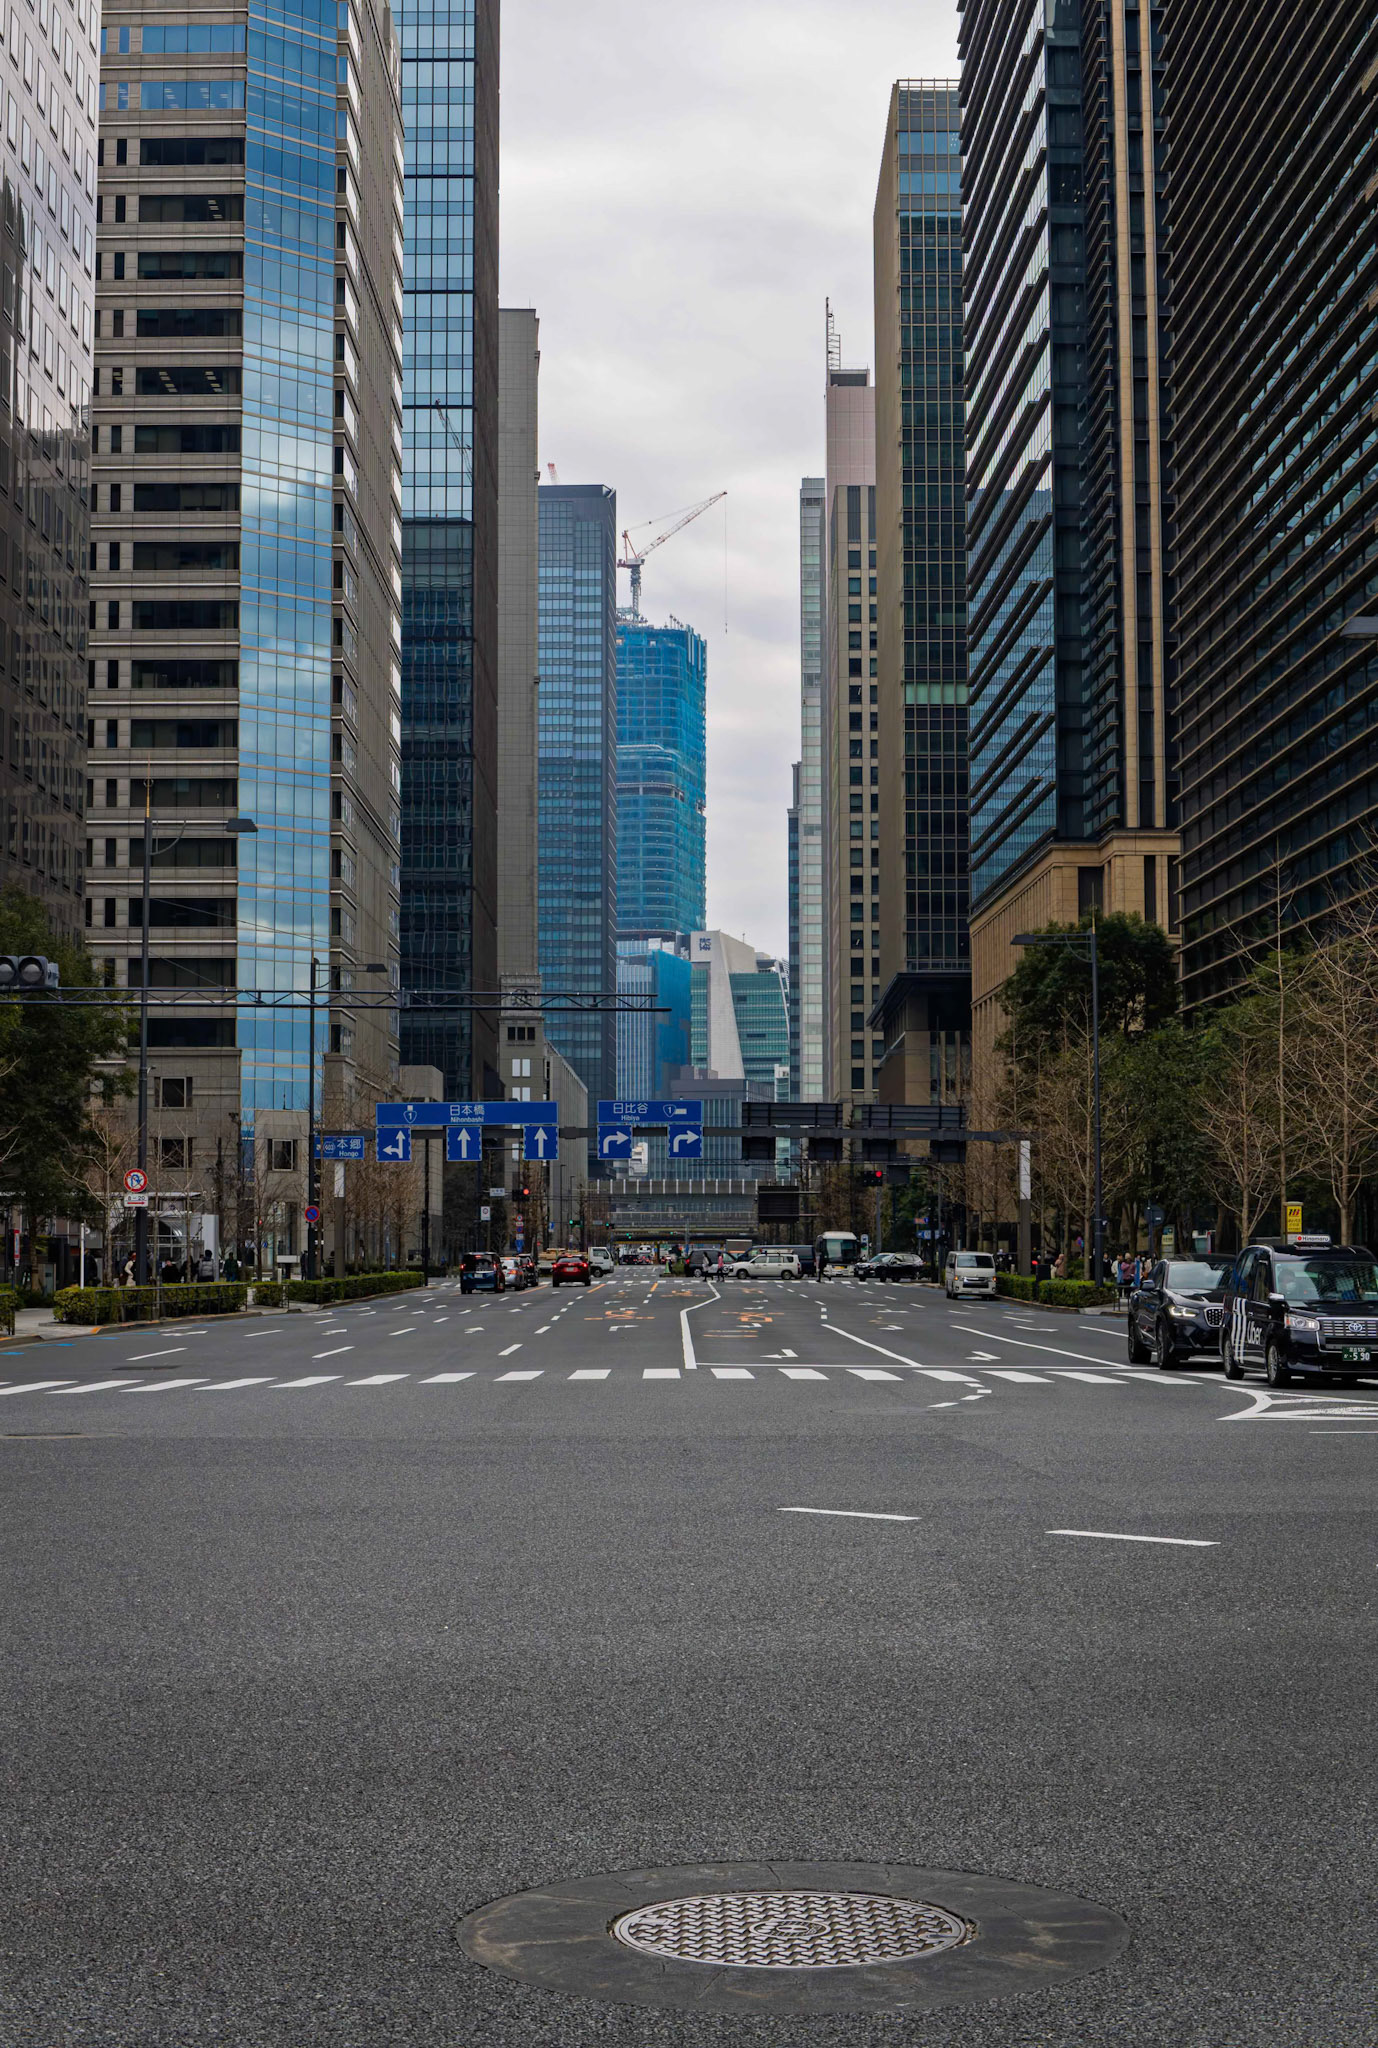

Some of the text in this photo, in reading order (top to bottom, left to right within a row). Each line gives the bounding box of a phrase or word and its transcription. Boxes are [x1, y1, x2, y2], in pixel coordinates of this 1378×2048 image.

[449, 1104, 485, 1116] 日本橋
[613, 1102, 648, 1114] 日比谷
[408, 1112, 412, 1120] 1
[336, 1138, 362, 1150] 本郷
[338, 1150, 359, 1158] Hongo
[1247, 1320, 1262, 1345] Uber
